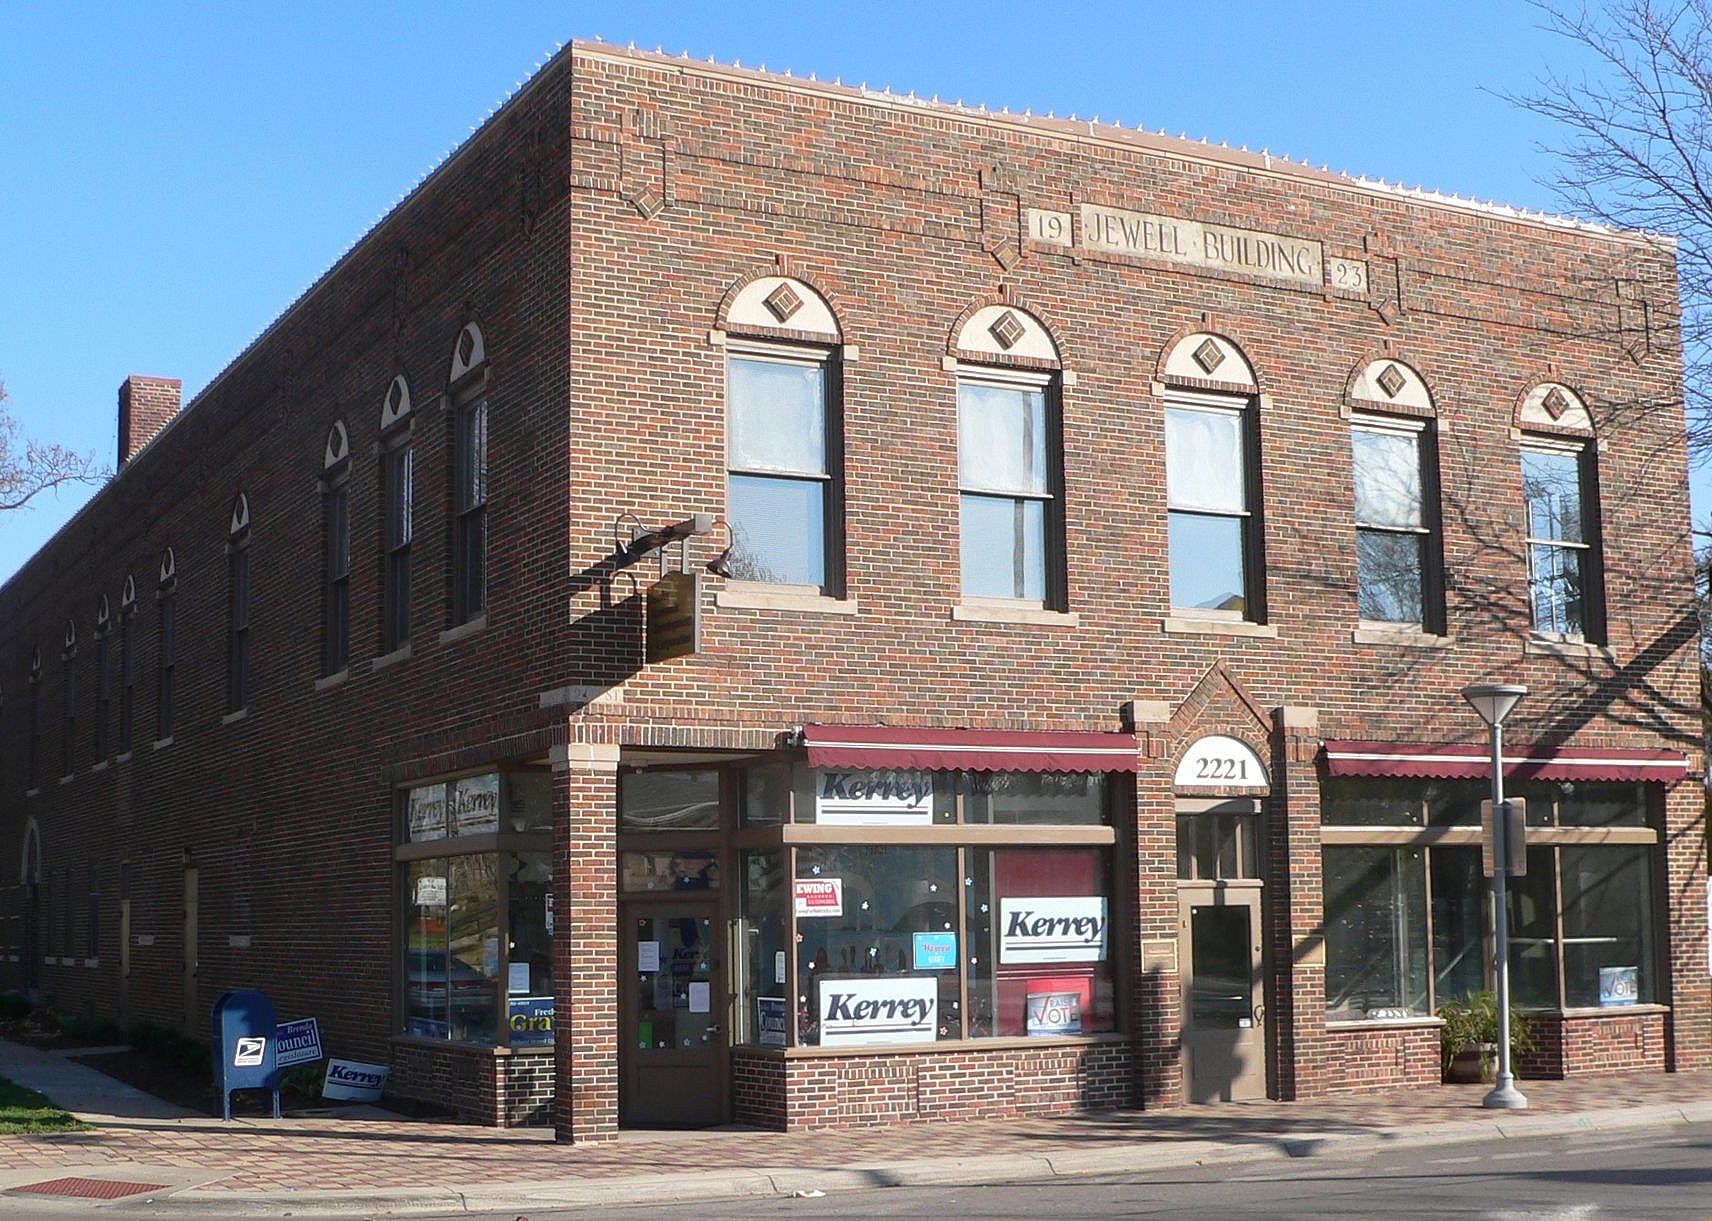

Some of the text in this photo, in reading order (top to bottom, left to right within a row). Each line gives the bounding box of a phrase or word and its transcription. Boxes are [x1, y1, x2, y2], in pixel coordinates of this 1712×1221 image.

[1038, 214, 1062, 239] 19
[1088, 212, 1313, 275] JEWELL BUILDING
[1336, 265, 1363, 287] 23
[1196, 757, 1249, 780] 2221
[820, 773, 931, 809] Kerrey
[796, 883, 833, 894] EWING
[1004, 911, 1105, 943] Kerrey
[824, 993, 935, 1026] Kerrey
[510, 1014, 555, 1032] Gra
[277, 1028, 317, 1052] ouncil
[328, 1065, 386, 1086] Kerrey
